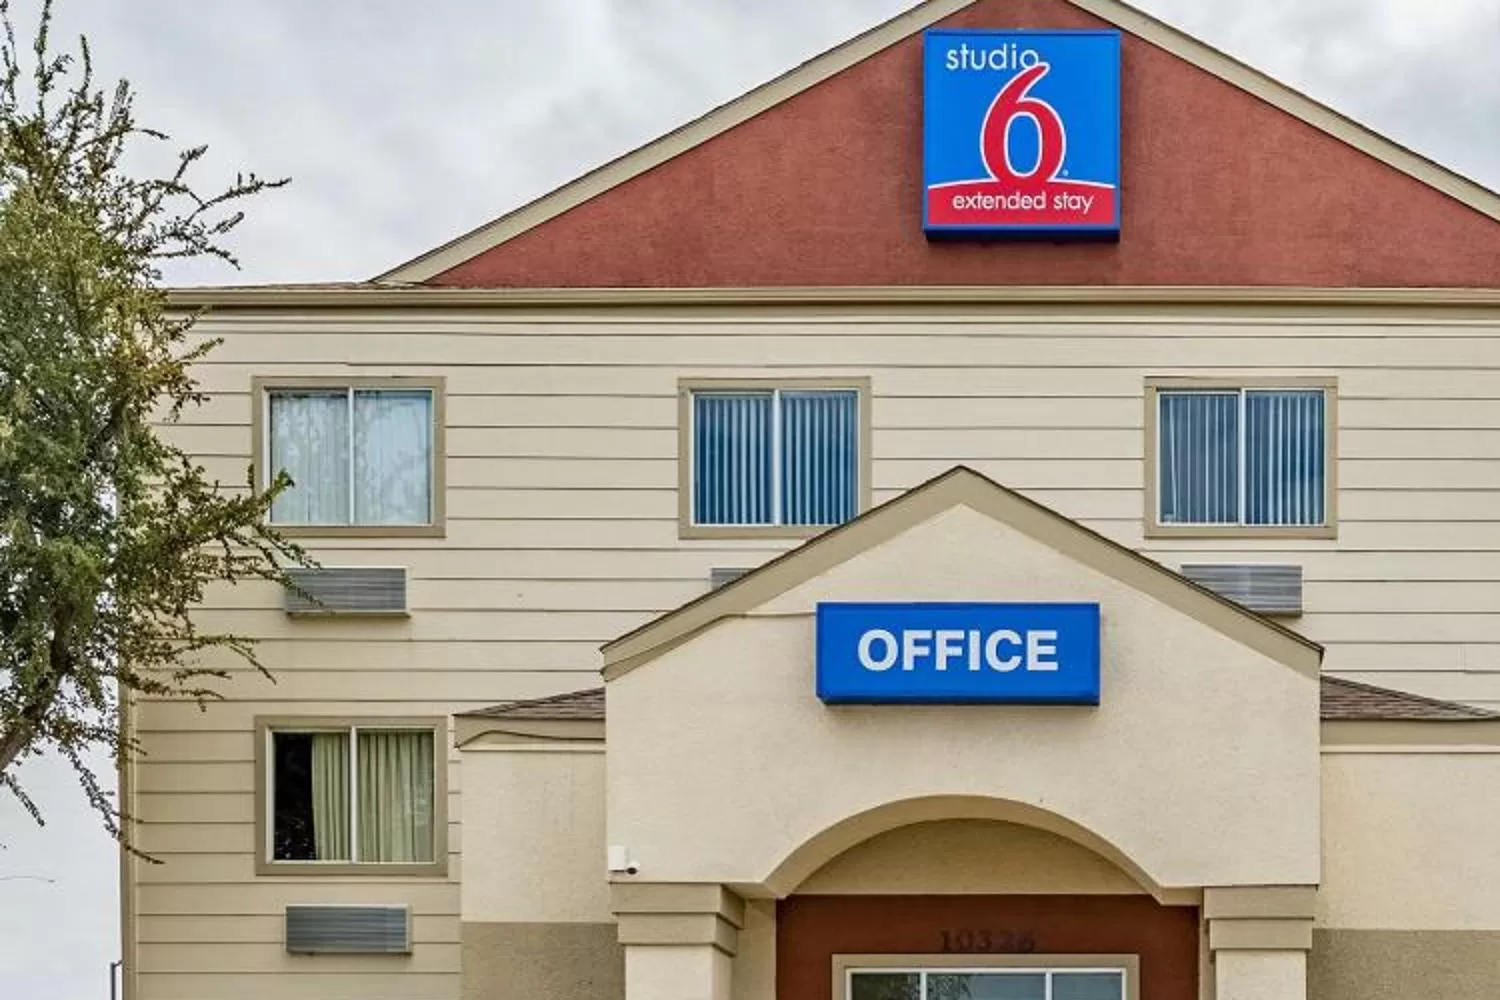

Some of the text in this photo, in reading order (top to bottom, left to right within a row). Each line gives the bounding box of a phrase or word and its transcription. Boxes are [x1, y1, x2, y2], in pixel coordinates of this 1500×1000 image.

[945, 43, 1039, 70] studio
[979, 62, 1067, 187] 6
[952, 192, 1094, 214] extended stay
[857, 629, 1059, 672] OFFICE
